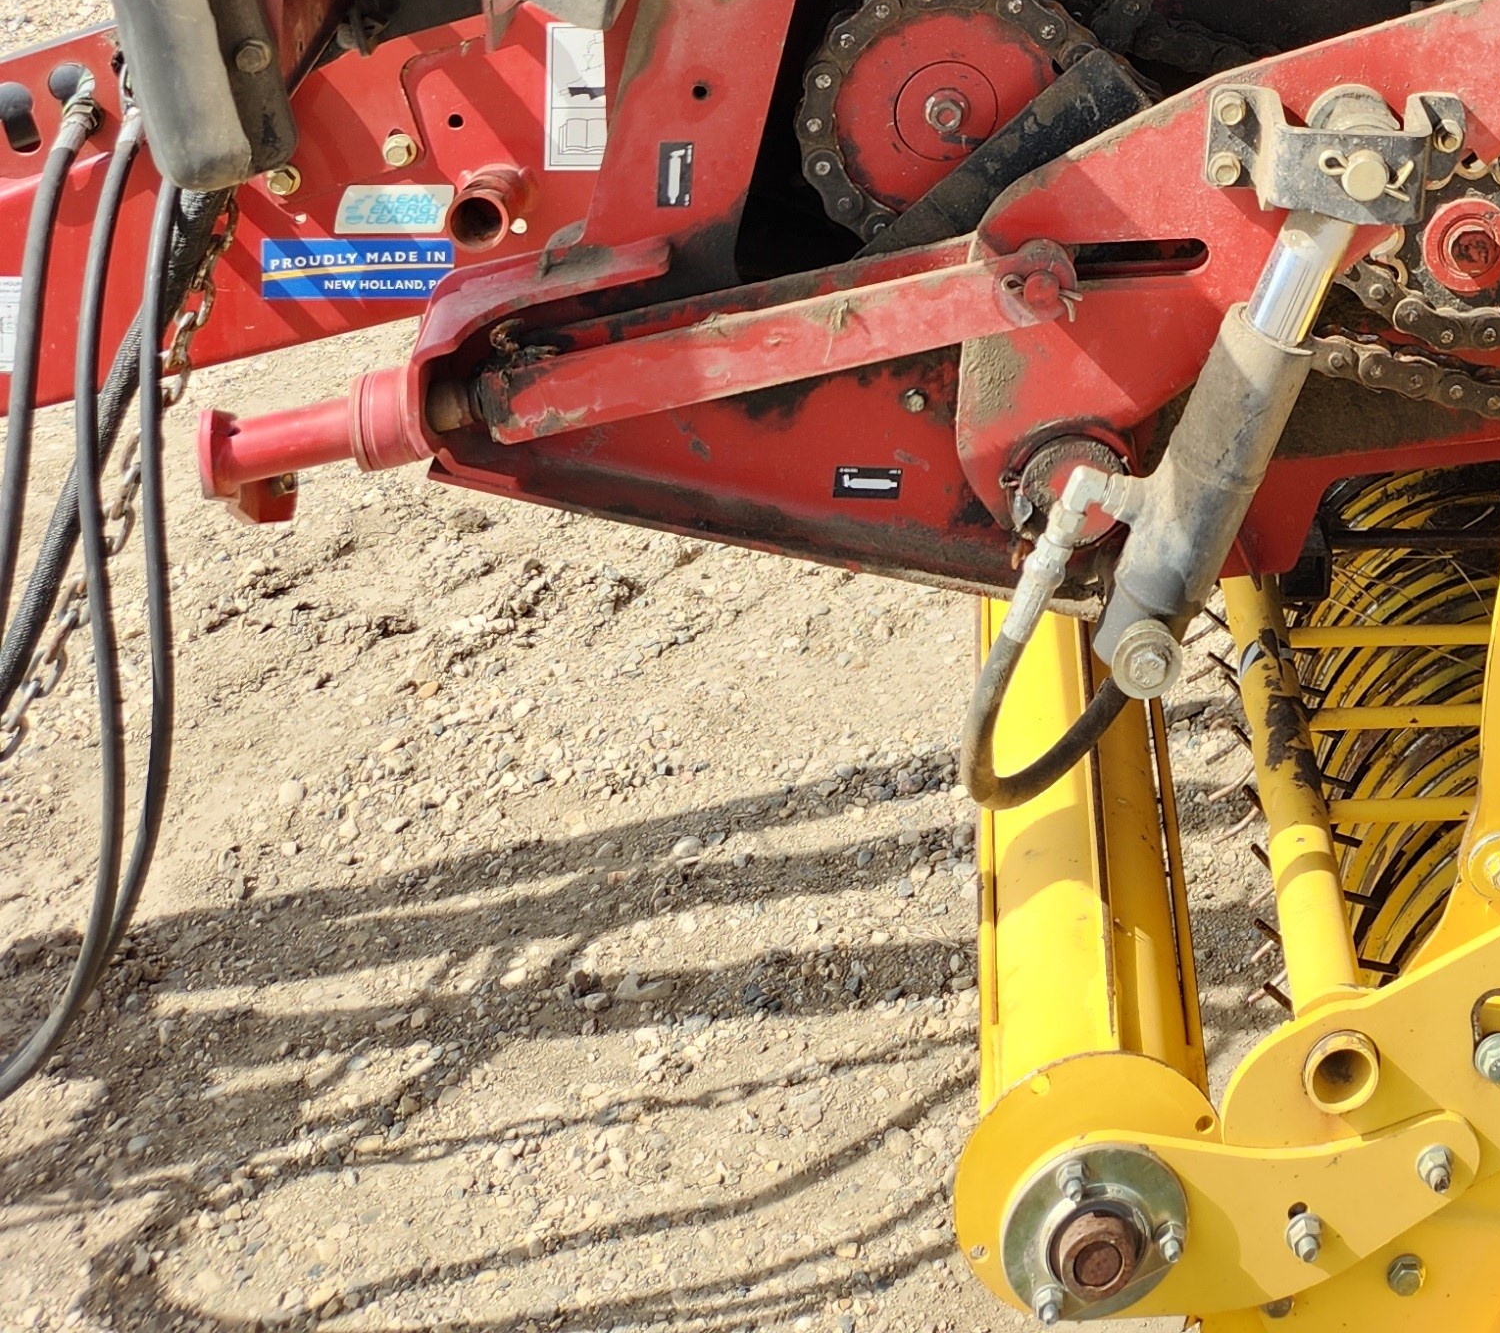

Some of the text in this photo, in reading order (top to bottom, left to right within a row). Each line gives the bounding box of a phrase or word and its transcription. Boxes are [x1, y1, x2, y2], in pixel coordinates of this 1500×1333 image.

[375, 194, 435, 204] CLEAN
[370, 203, 446, 214] ENERGY
[366, 214, 438, 224] LEADER
[269, 251, 446, 270] PROUDLY MADE IN
[324, 279, 357, 290] NEW
[359, 279, 427, 291] HOLLAND,
